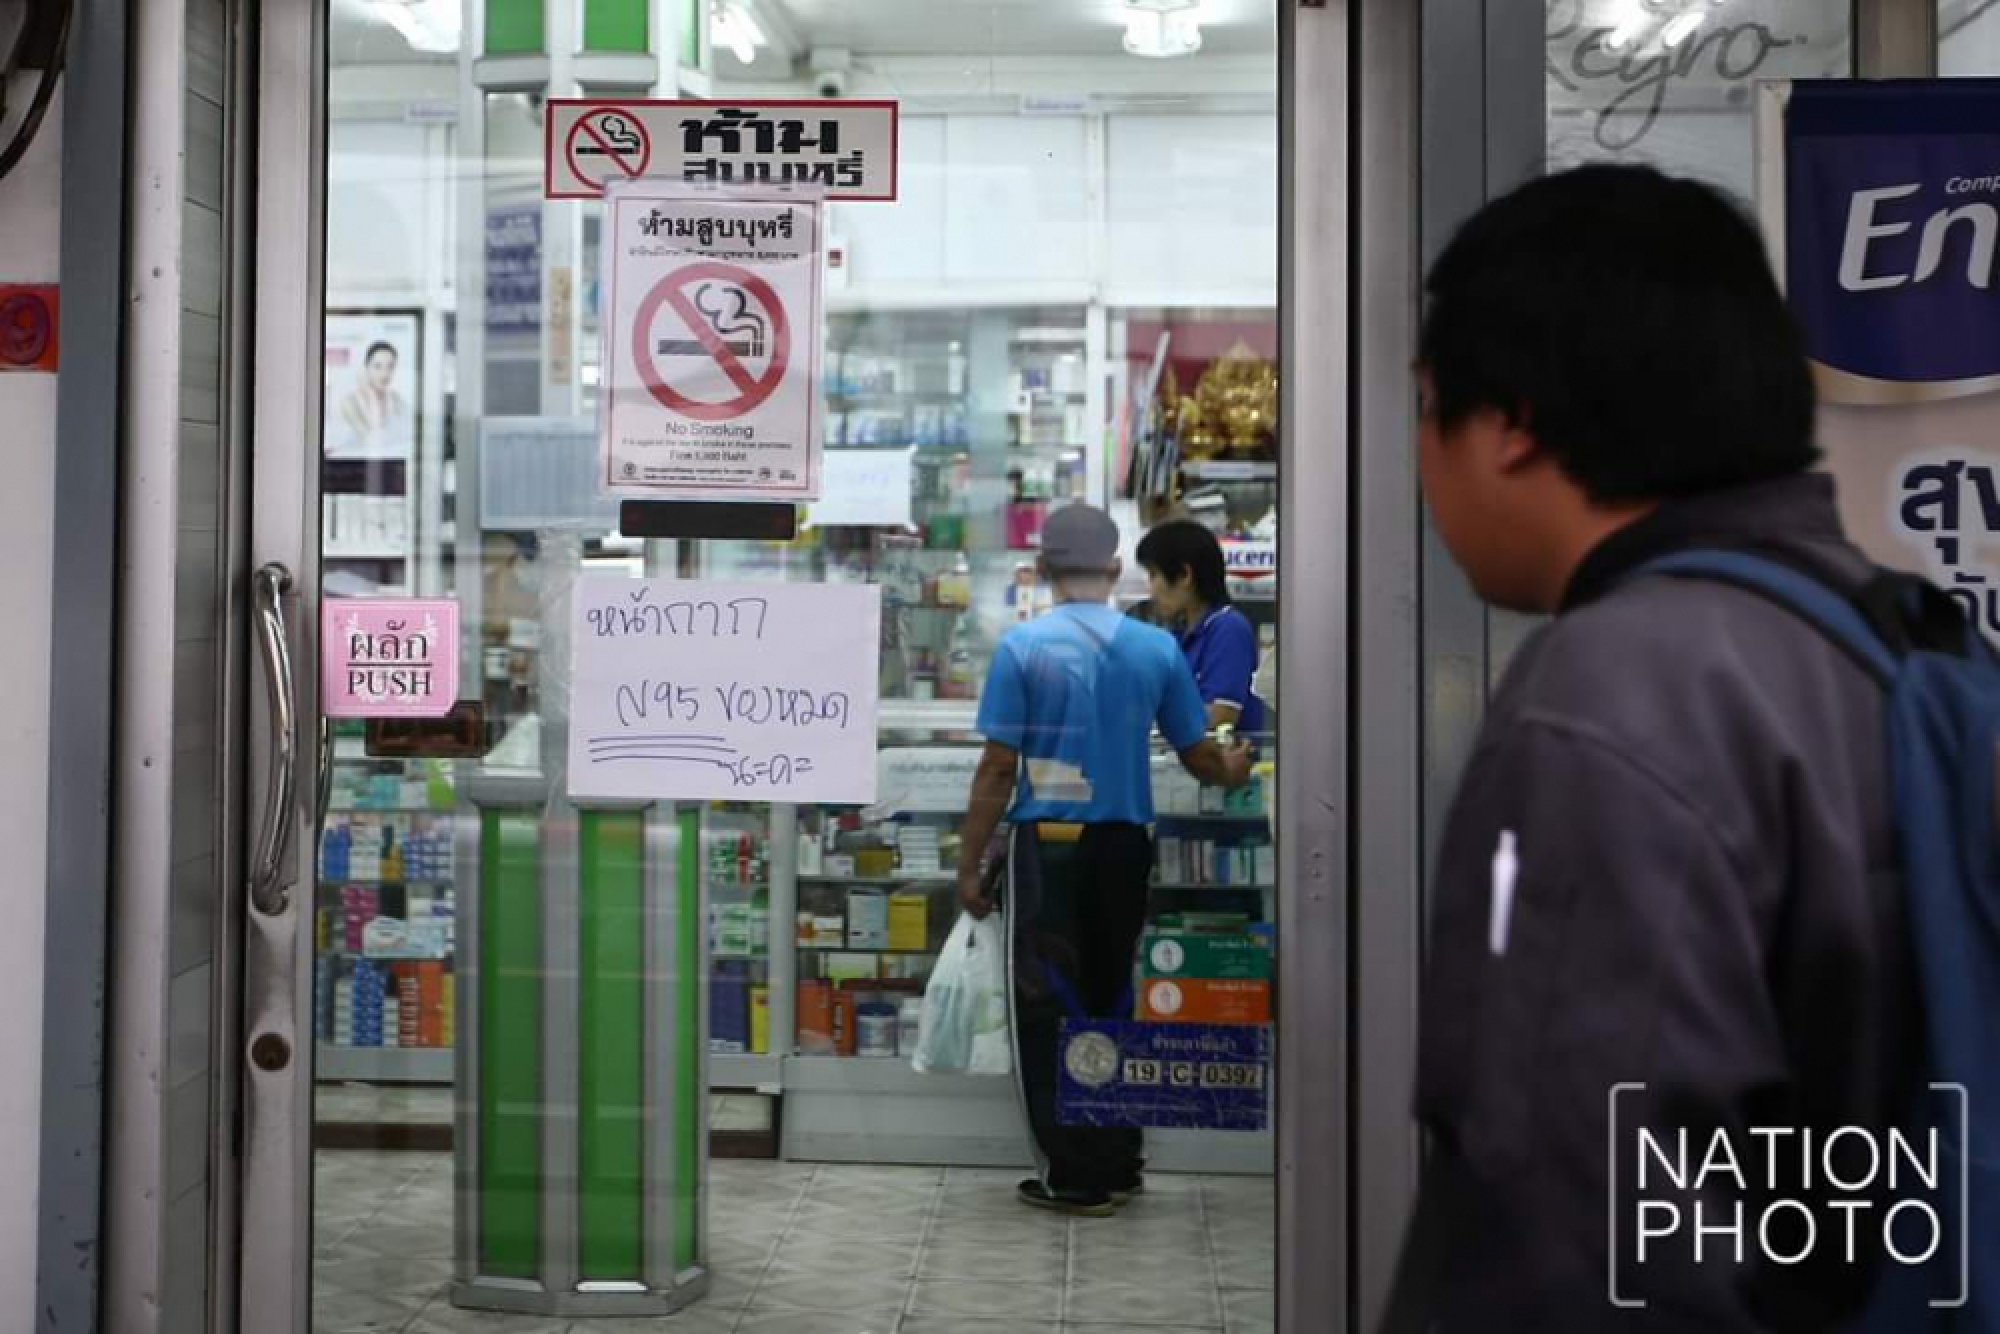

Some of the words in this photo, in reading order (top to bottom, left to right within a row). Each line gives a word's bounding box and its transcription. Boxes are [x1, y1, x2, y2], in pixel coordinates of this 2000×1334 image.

[680, 108, 840, 155] ห้าม
[638, 207, 794, 246] ห้ามสูบบุหรี่
[690, 422, 754, 439] Smoking
[351, 619, 427, 661] ผลัก
[347, 670, 431, 697] PUSH
[615, 679, 699, 726] N95
